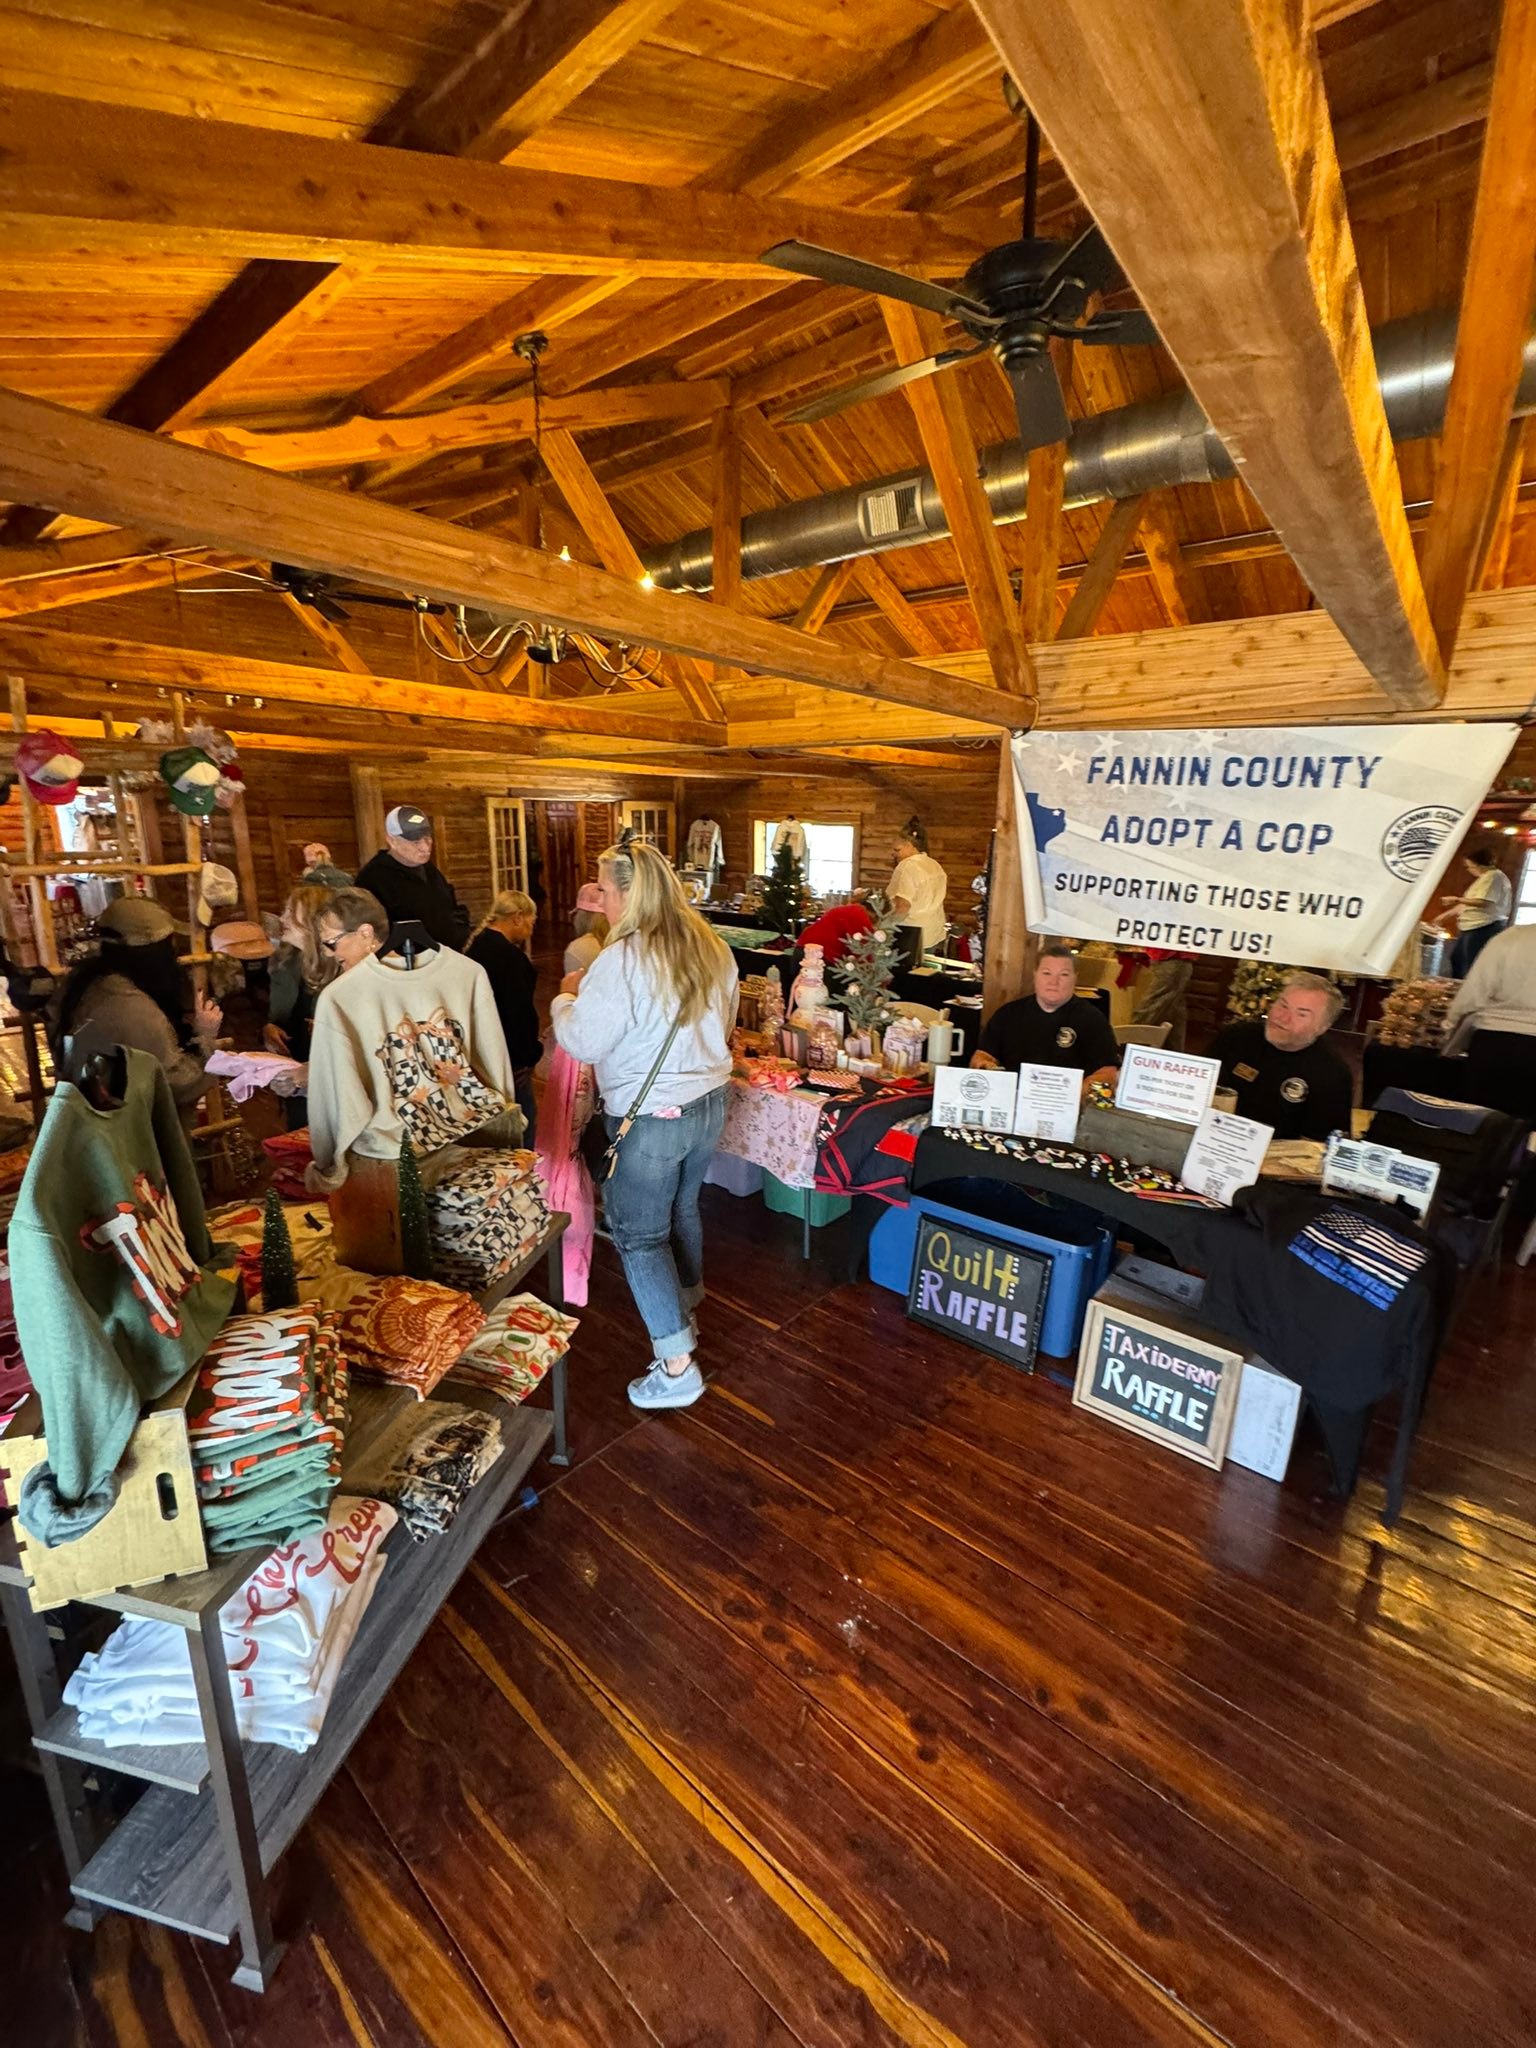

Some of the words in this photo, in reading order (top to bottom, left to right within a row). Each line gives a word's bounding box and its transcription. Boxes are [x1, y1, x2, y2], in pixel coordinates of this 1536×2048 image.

[1087, 756, 1211, 786] FANNIN
[1222, 756, 1383, 788] COUNTY
[1100, 815, 1213, 849] ADOPT
[1220, 820, 1243, 850] A
[1256, 822, 1334, 855] COP
[1054, 872, 1199, 904] SUPPORTING
[1207, 884, 1291, 912] THOSE
[1299, 891, 1364, 919] WHO
[1116, 918, 1224, 949] PROTECT
[1230, 930, 1273, 955] US!
[1133, 1056, 1160, 1069] GUN
[1163, 1062, 1208, 1079] RAFFLE
[928, 1231, 1020, 1298] Quilt
[921, 1269, 1027, 1348] RAFFLE
[1101, 1358, 1208, 1432] RAFFLE
[305, 1498, 384, 1584] Crew
